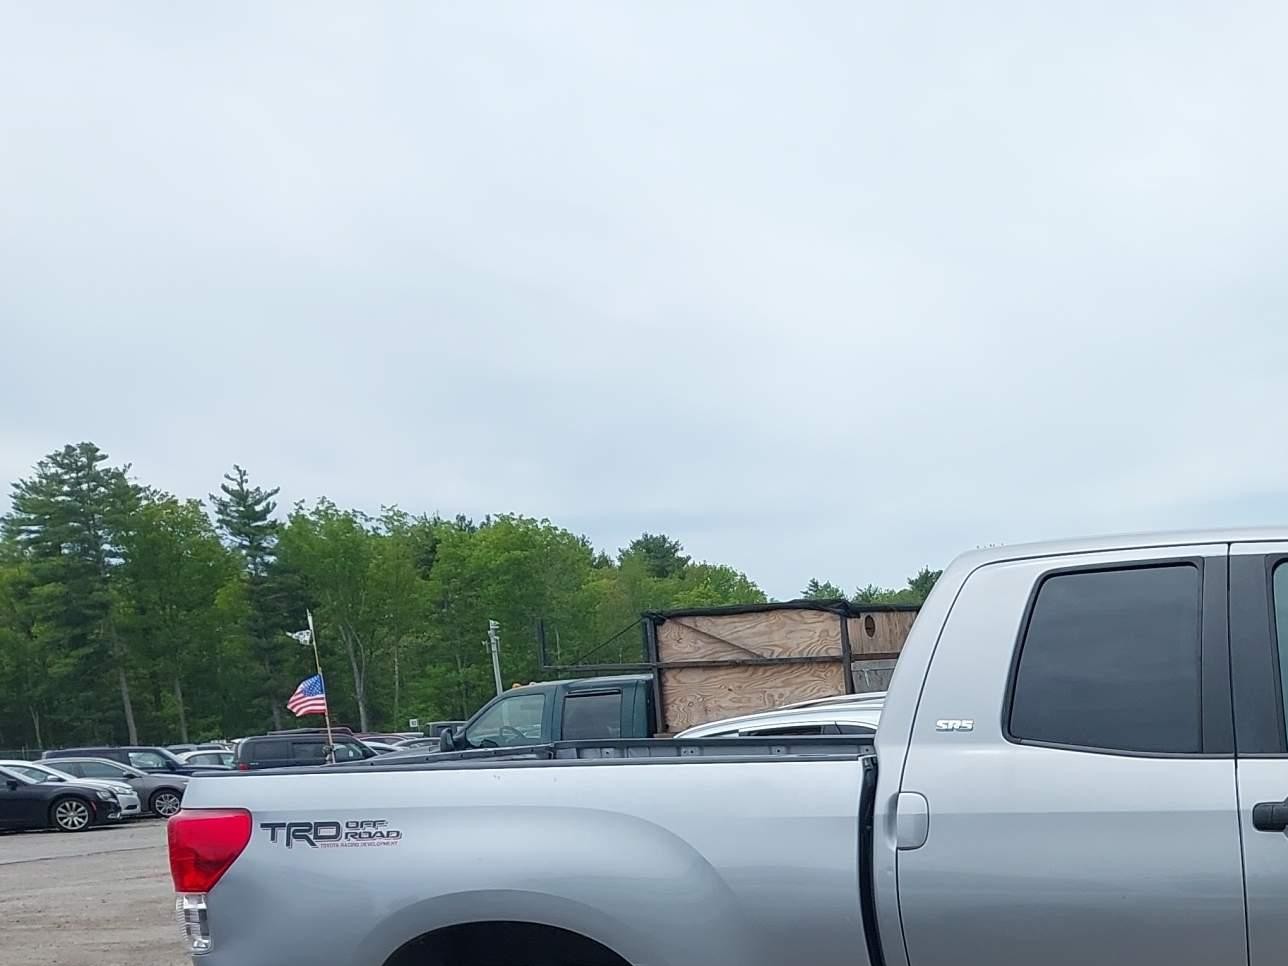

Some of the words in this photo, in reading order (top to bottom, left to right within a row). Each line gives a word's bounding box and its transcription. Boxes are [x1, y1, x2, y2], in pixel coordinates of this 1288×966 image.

[346, 820, 388, 831] OFF
[260, 821, 342, 848] TRD
[345, 830, 402, 842] ROAD
